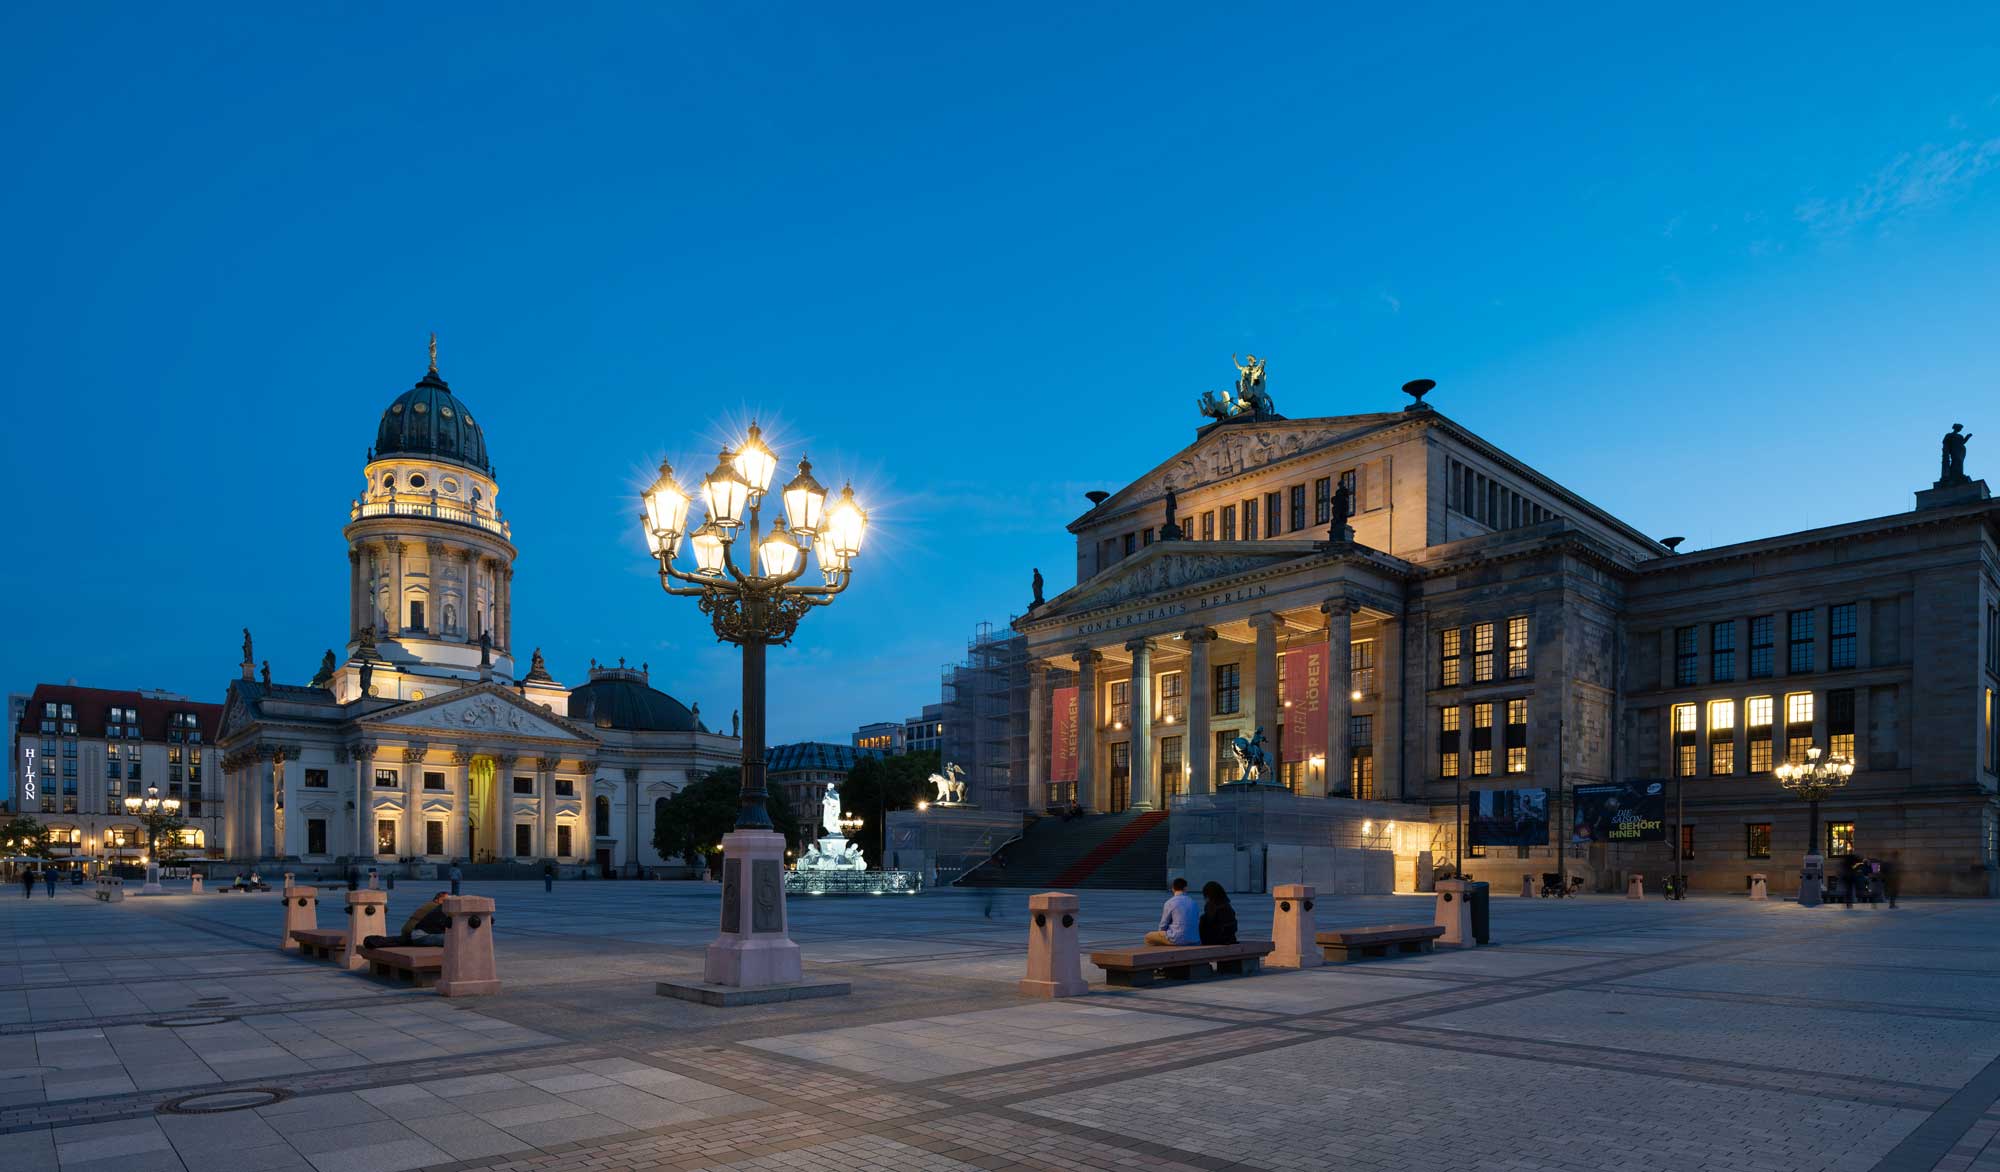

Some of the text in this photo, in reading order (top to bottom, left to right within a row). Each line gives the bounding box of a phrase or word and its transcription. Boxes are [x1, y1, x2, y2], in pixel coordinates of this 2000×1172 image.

[1078, 584, 1267, 634] KONZERTHAUS BERLIN
[1306, 653, 1320, 712] HÖREN
[1068, 696, 1078, 757] NEHMEN
[1294, 699, 1306, 735] REIN
[25, 748, 36, 800] HILTON
[1611, 815, 1642, 824] SAISON
[1617, 809, 1632, 817] DIE
[1619, 820, 1662, 830] GEHÖRT
[1609, 829, 1640, 838] IHNEN
